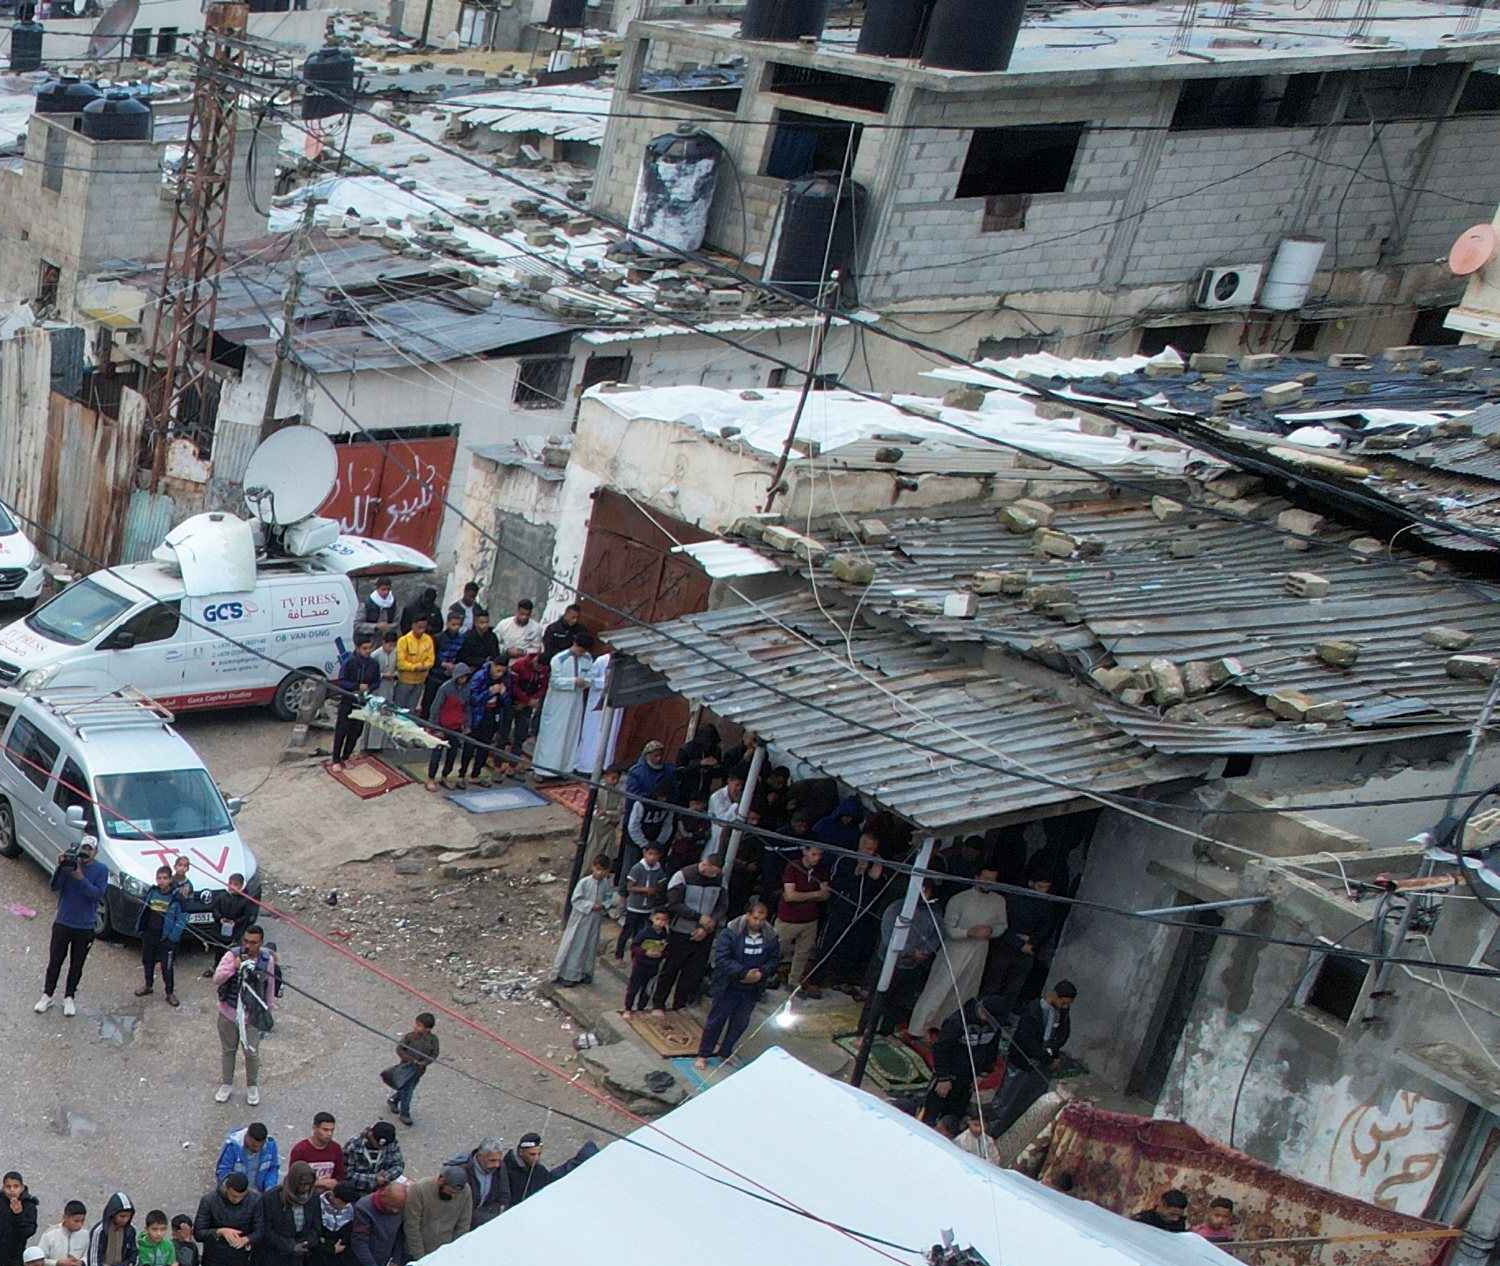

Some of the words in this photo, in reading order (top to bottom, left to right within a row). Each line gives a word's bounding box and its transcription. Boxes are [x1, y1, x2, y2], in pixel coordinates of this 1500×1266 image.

[280, 597, 296, 608] TV
[300, 593, 337, 606] PRESS
[203, 601, 243, 622] GCS
[287, 608, 330, 619] صحافة
[140, 846, 230, 874] TV
